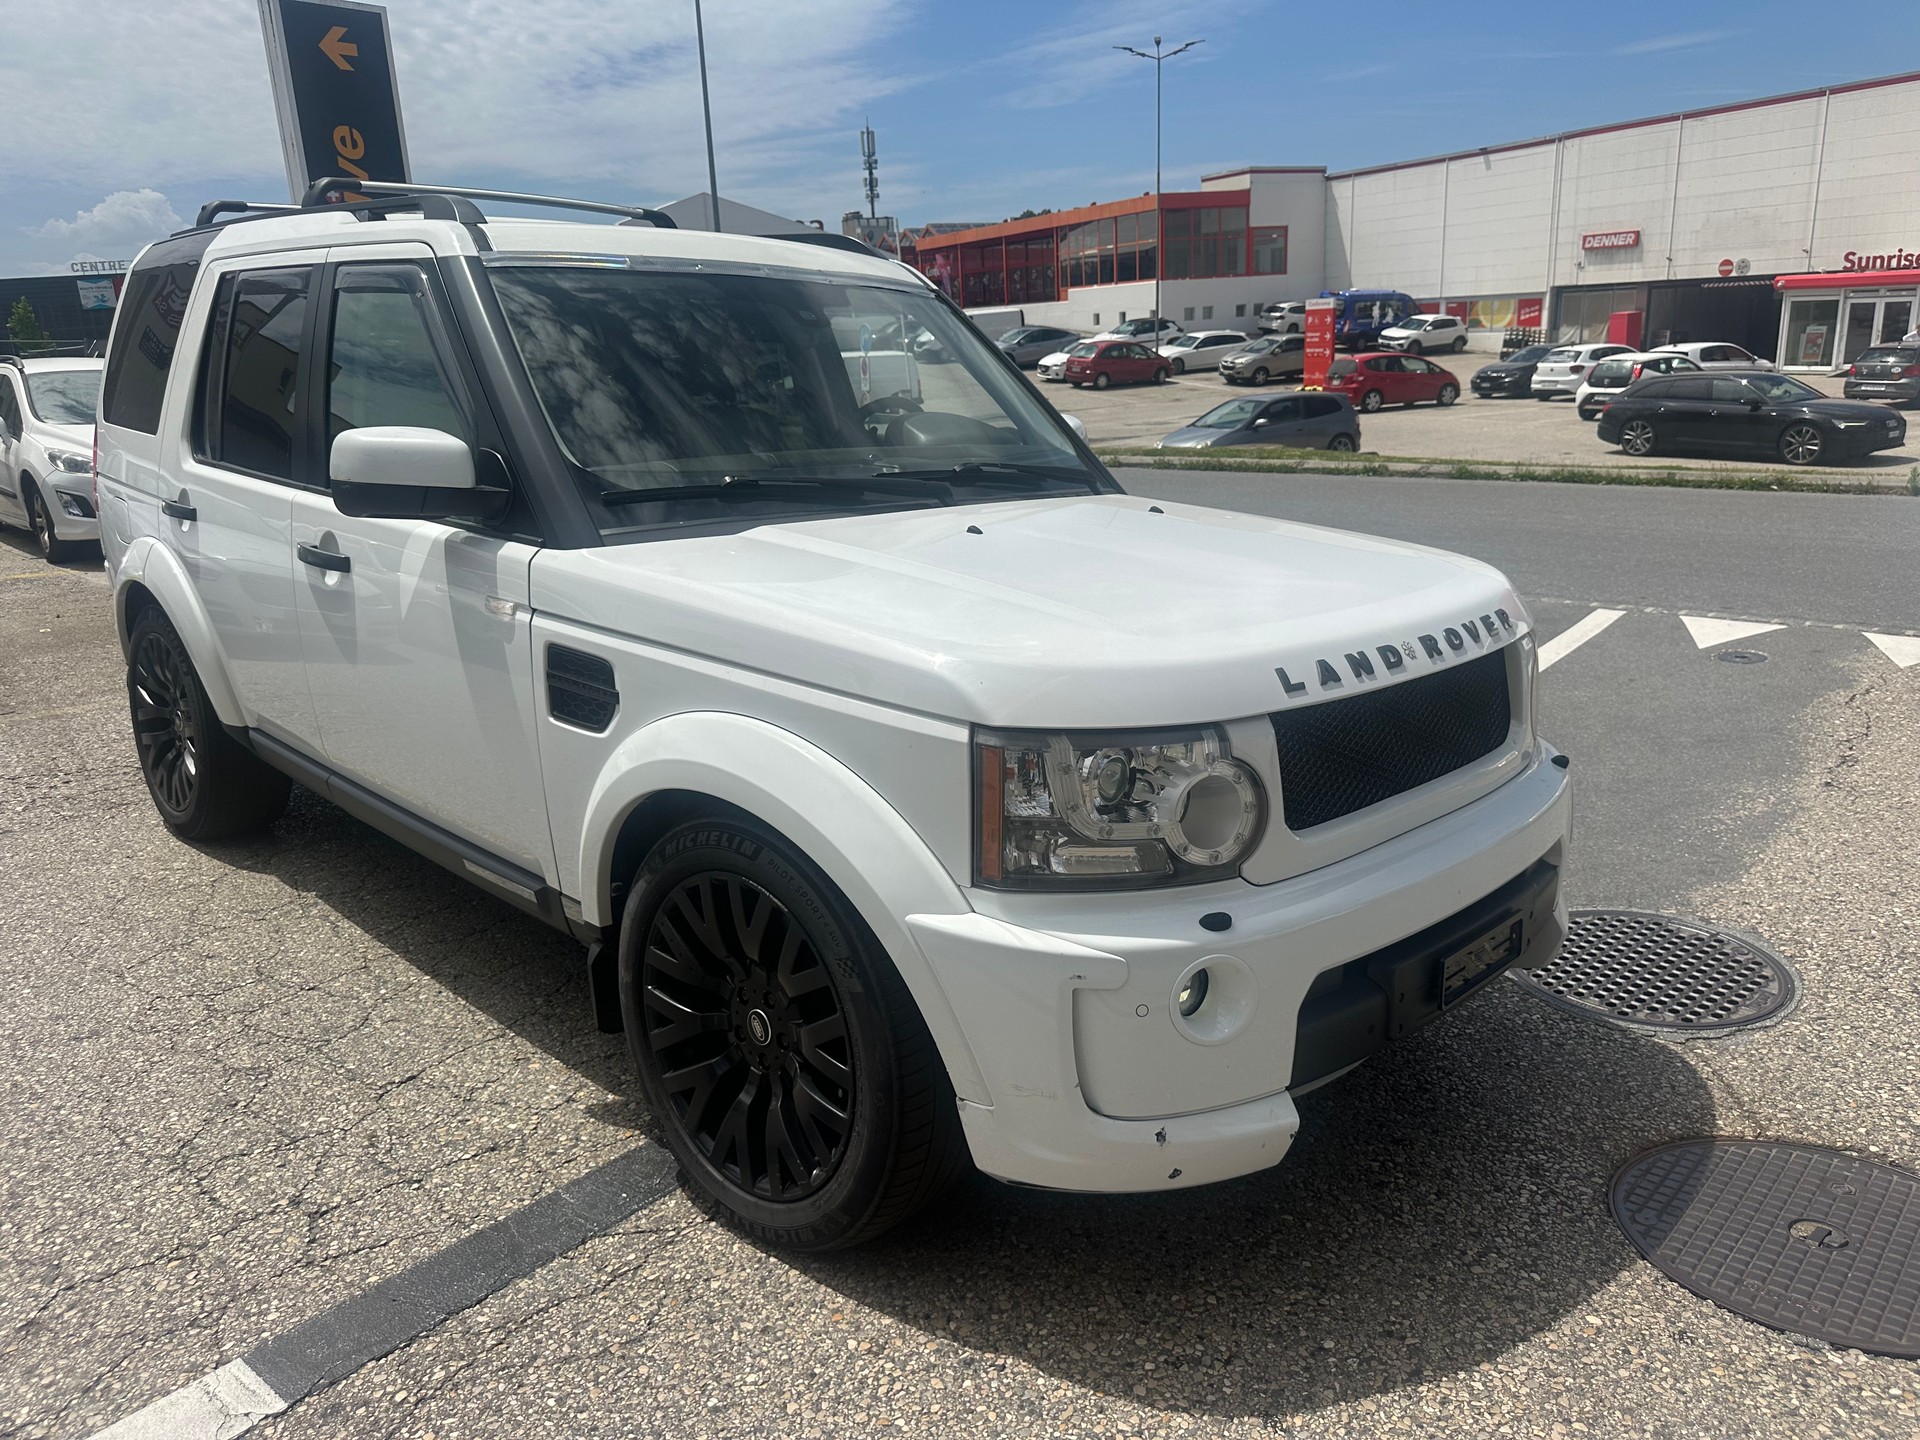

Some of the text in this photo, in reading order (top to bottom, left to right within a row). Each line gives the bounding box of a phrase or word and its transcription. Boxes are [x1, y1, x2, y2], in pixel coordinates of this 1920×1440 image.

[1584, 233, 1635, 248] DENNER
[71, 260, 127, 272] CENTRE
[1274, 608, 1513, 694] LAND ROVER
[665, 831, 755, 856] MICHELIN
[767, 858, 794, 884] PILOT
[794, 885, 826, 921] SPORT
